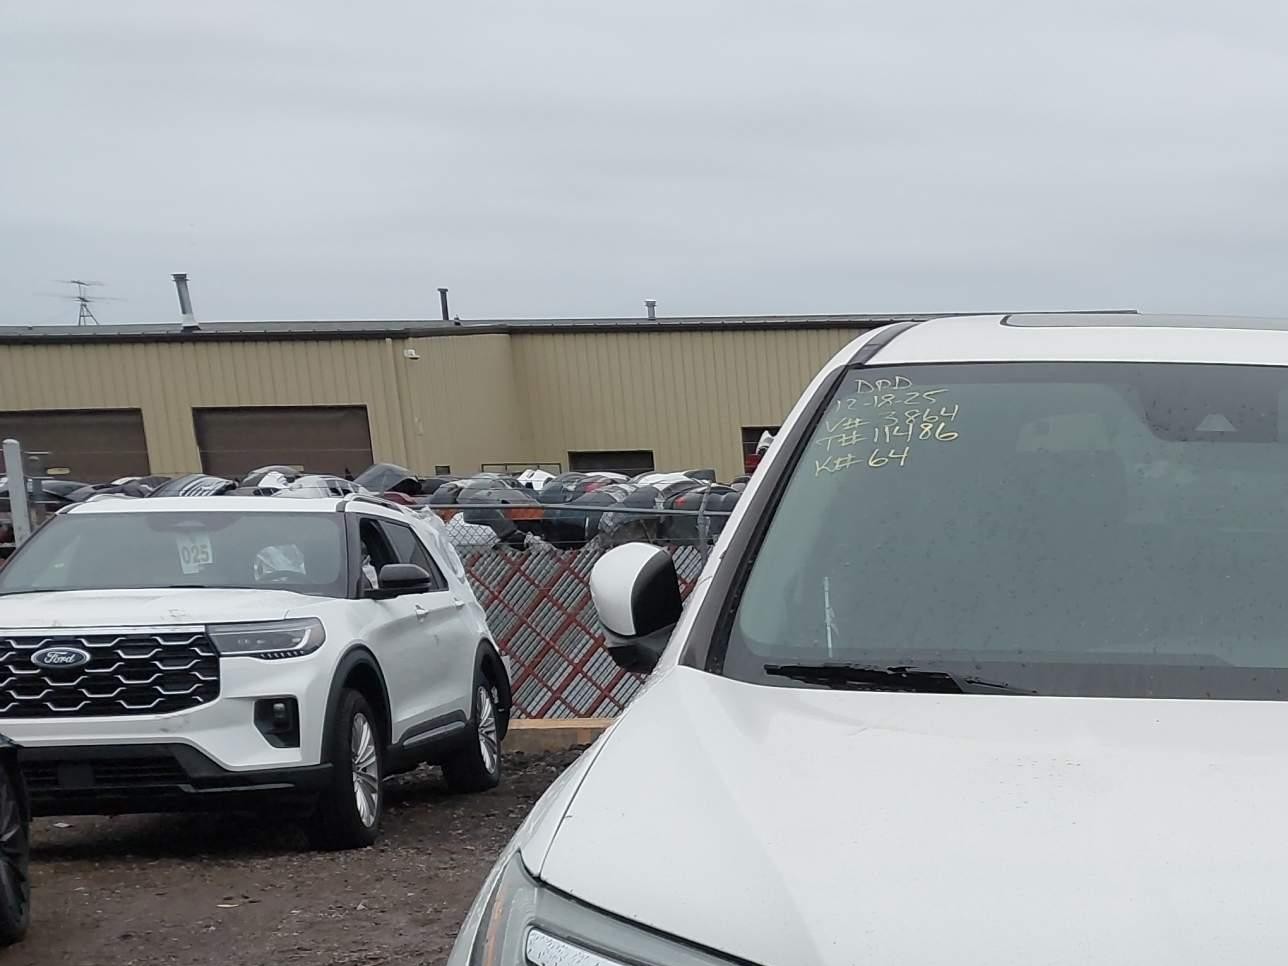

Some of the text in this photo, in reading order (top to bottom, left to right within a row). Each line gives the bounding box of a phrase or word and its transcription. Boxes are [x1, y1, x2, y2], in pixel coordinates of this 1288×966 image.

[814, 446, 910, 476] K# 64
[43, 651, 76, 664] Ford
